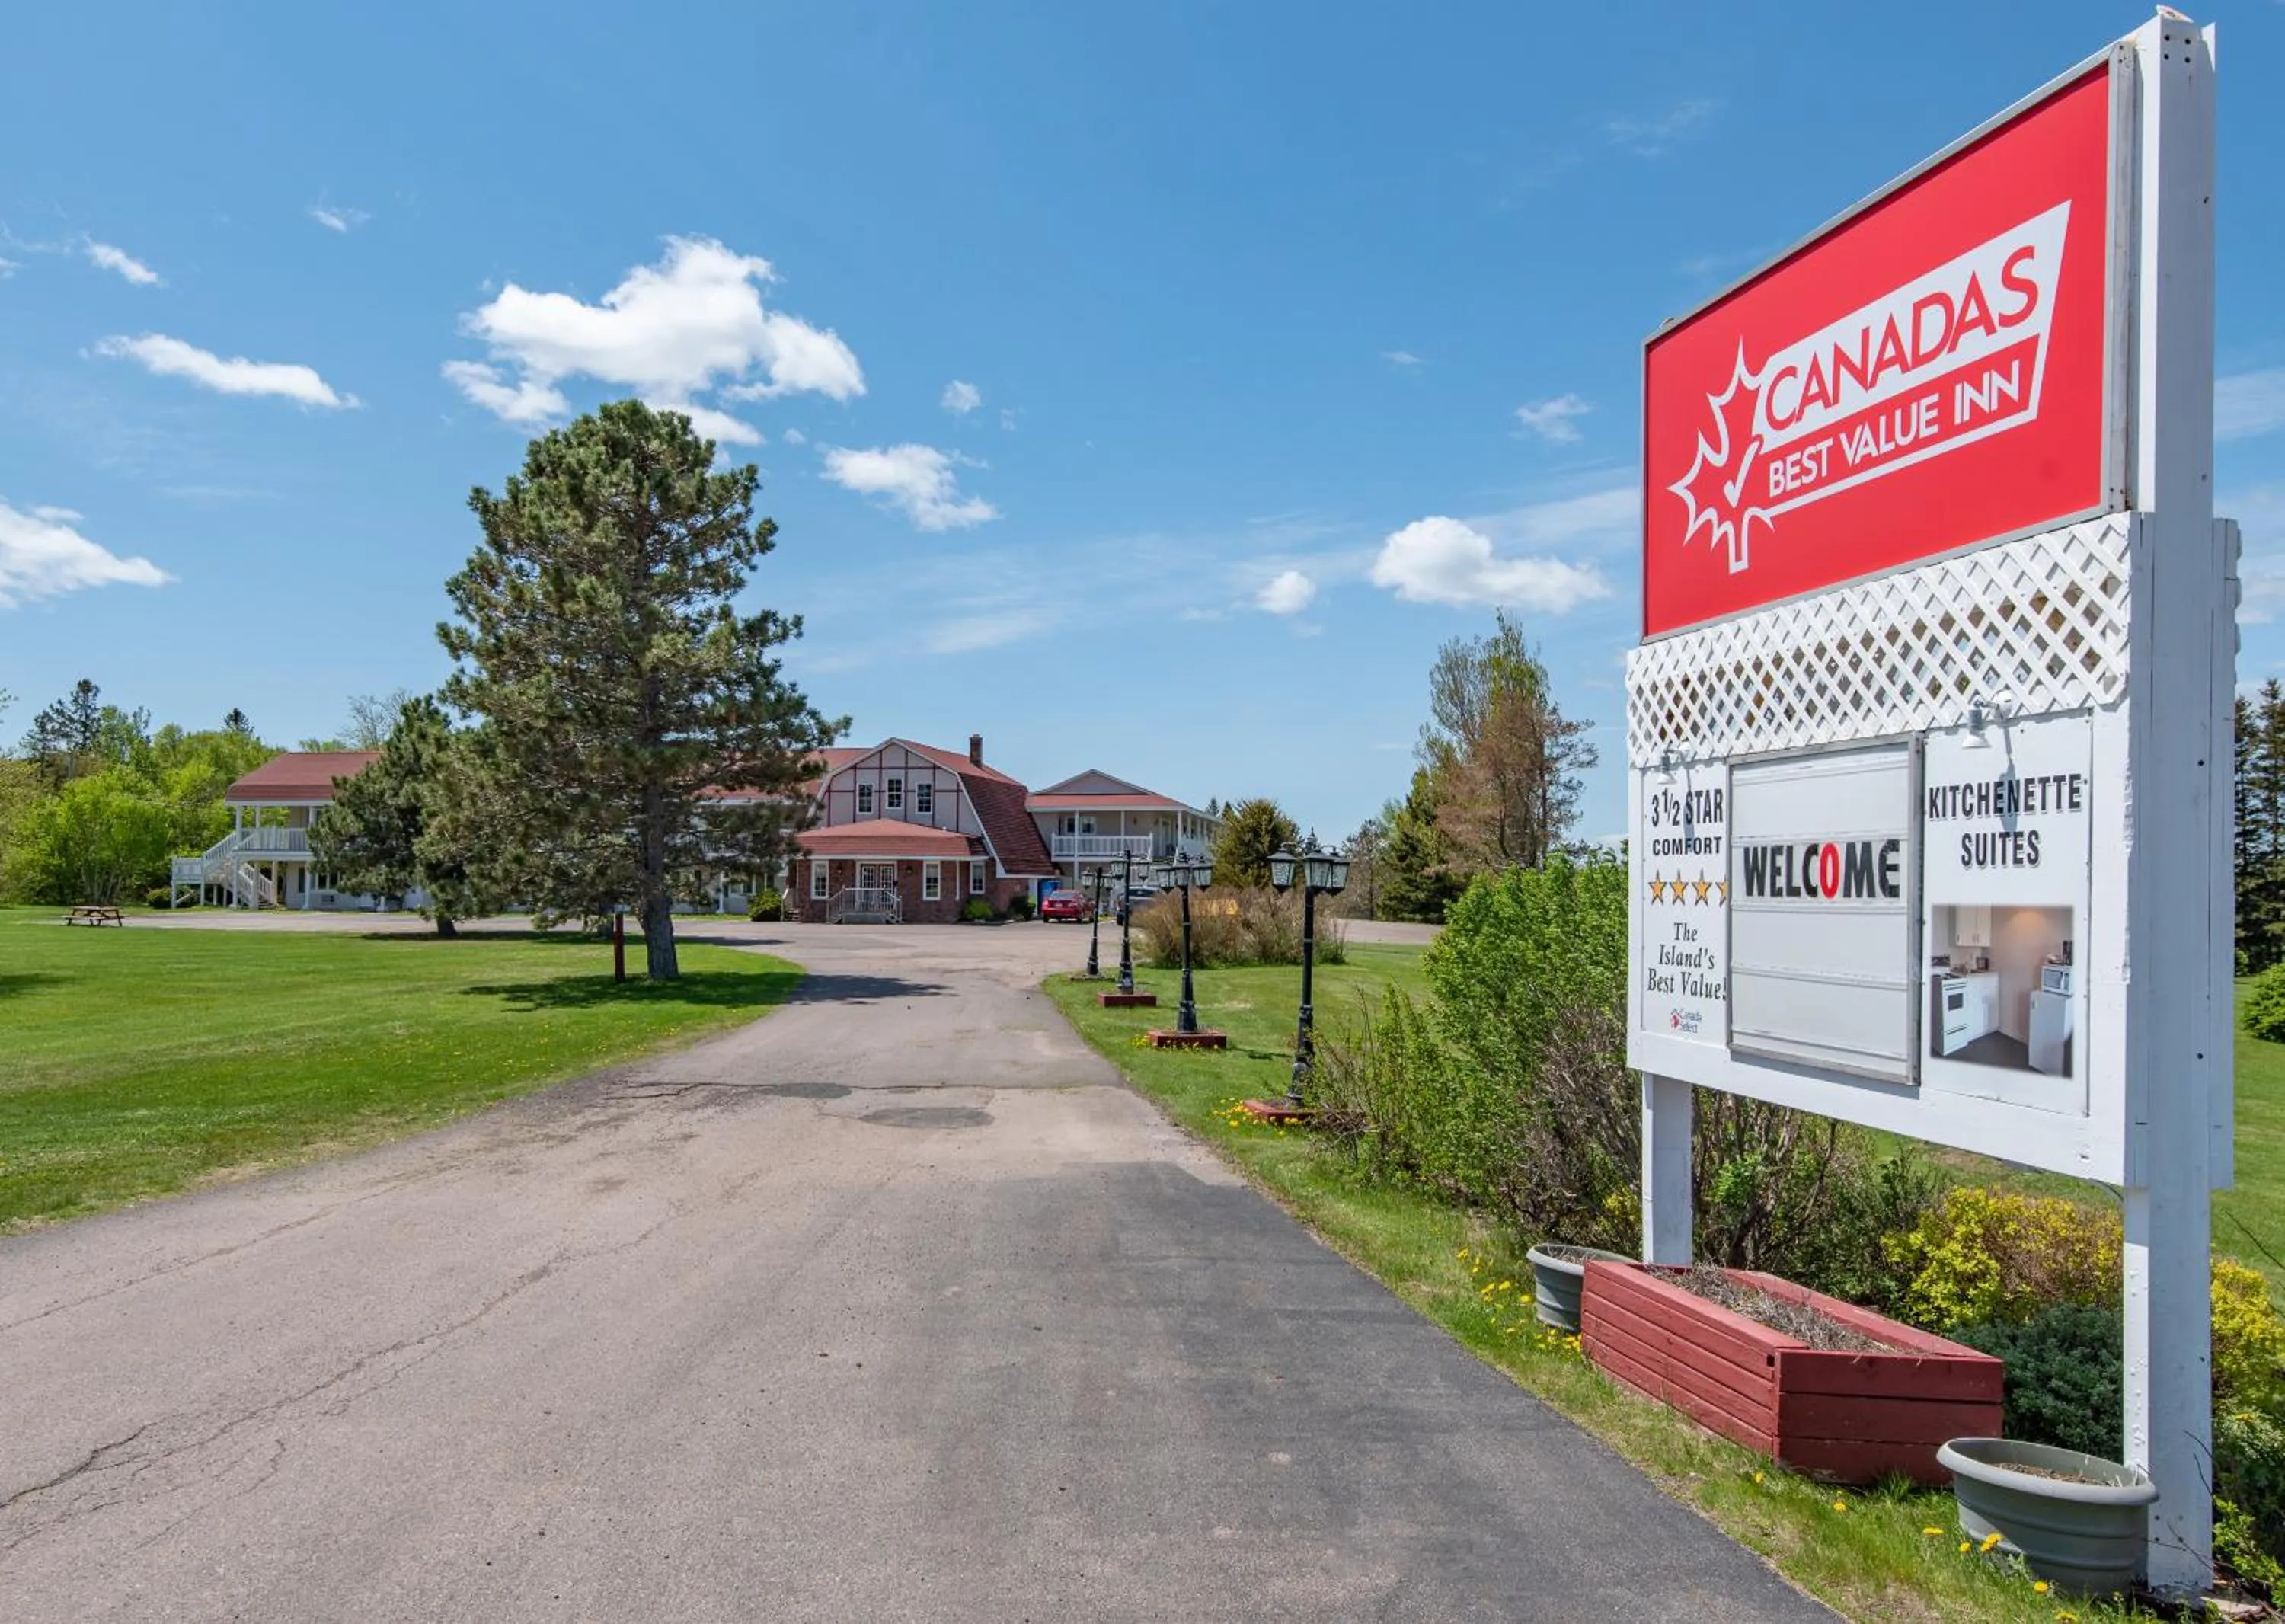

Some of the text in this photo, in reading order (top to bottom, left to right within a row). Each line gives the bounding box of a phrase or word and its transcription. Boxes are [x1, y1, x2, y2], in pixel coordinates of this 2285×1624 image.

[1766, 245, 2040, 430] CANADAS
[1769, 360, 2020, 498] BEST VALUE INN
[1686, 789, 1723, 824] STAR
[1929, 773, 2082, 820] KITCHENETTE
[1652, 836, 1722, 855] COMFORT
[1961, 830, 2041, 868] SUITES
[1743, 839, 1900, 898] WELCOME
[1674, 922, 1698, 941] The
[1658, 945, 1715, 970] Island's
[1647, 967, 1674, 994] Best
